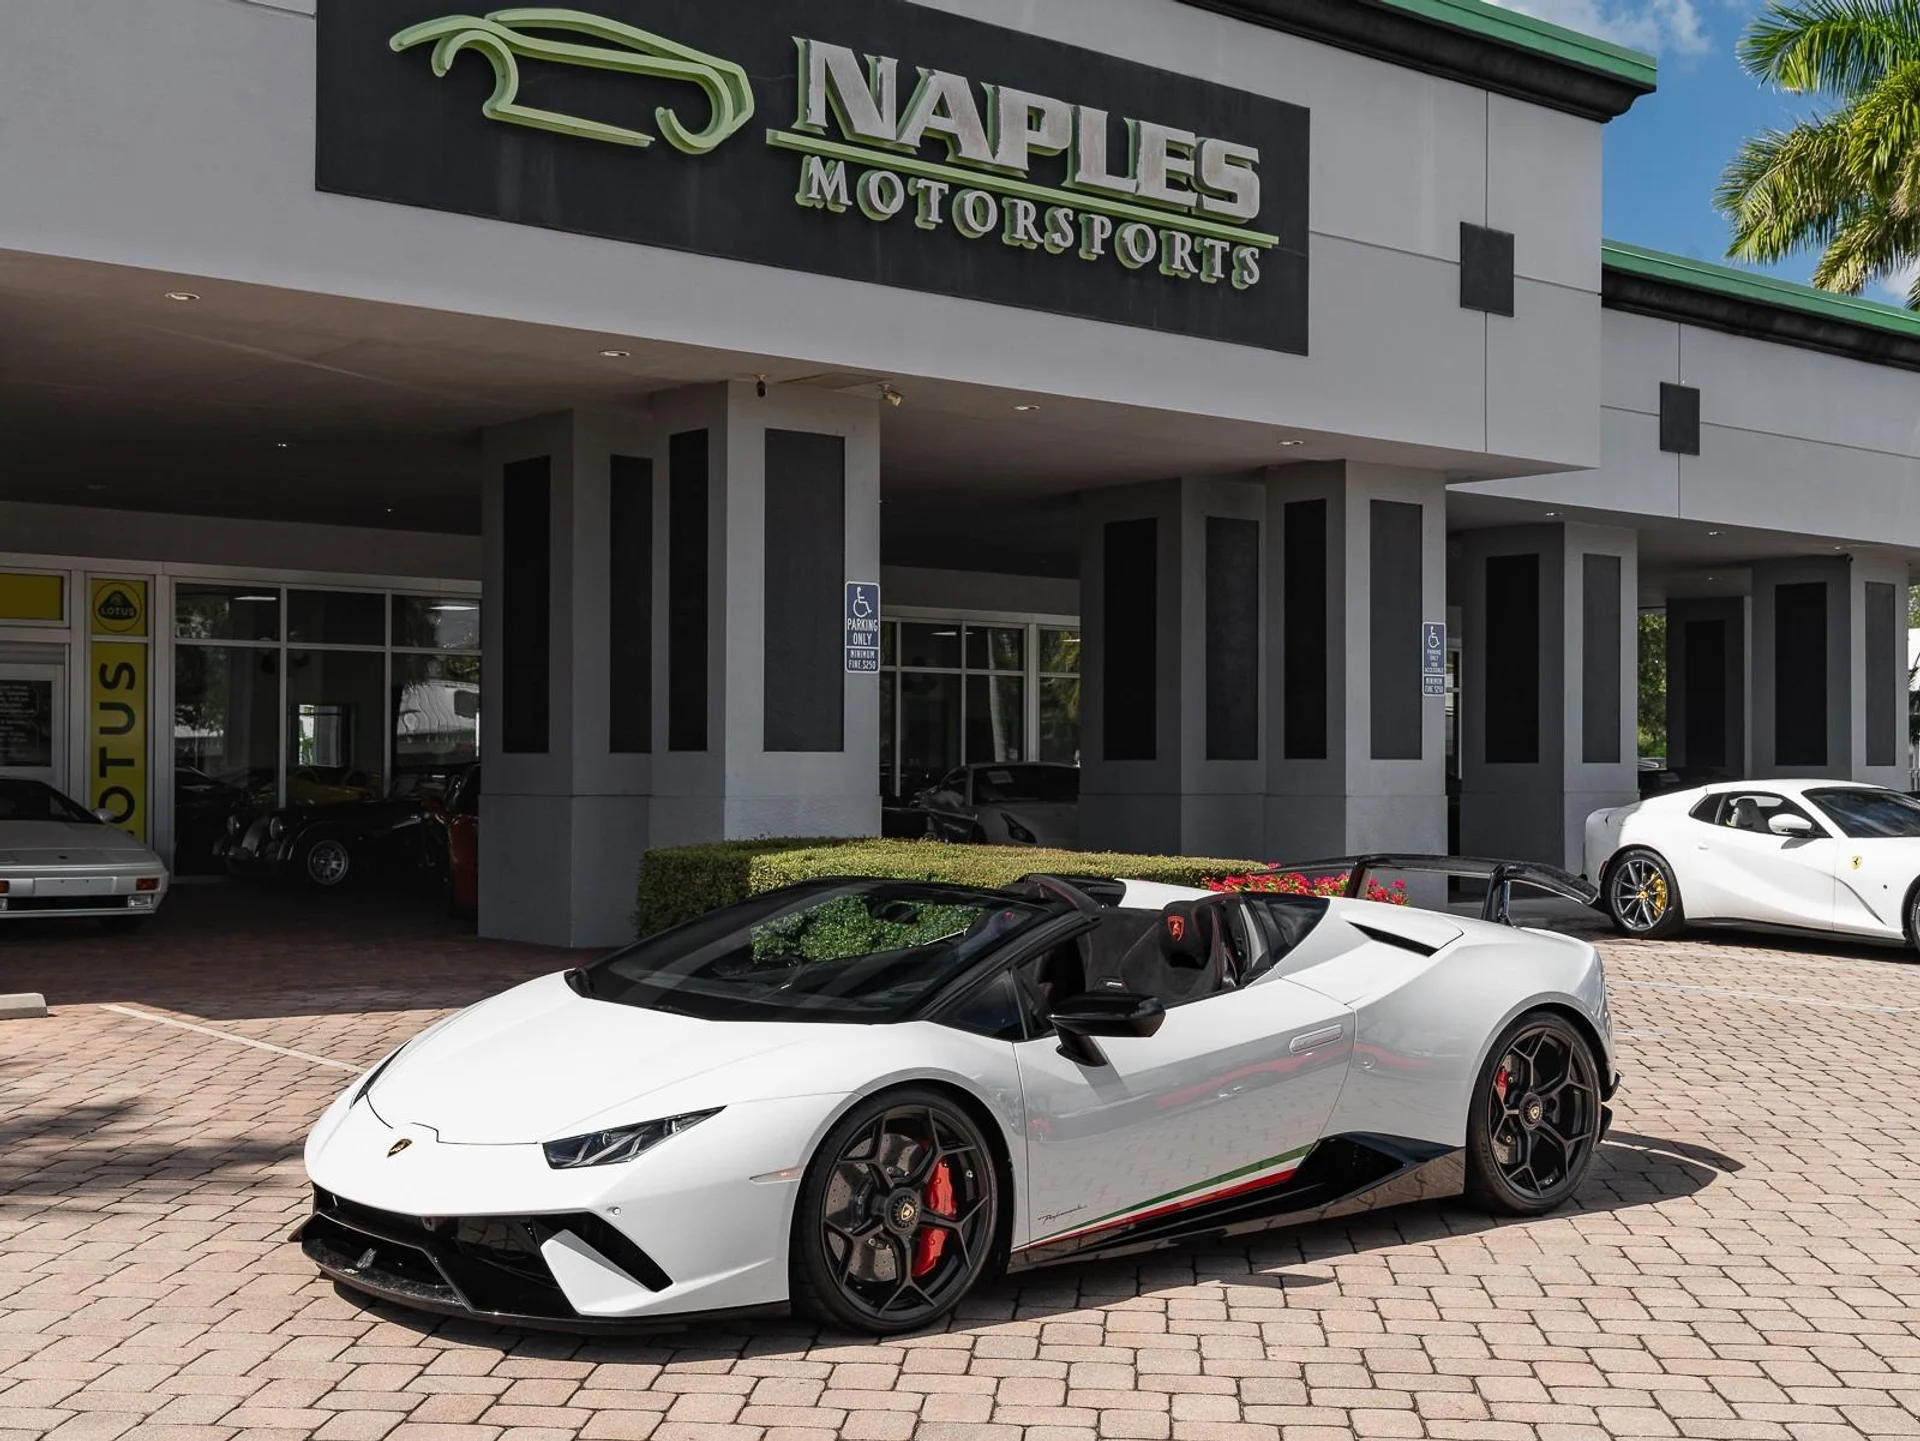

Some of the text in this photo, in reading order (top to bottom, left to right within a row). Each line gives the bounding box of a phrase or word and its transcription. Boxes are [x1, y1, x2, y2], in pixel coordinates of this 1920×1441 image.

[790, 36, 1261, 225] NAPLES
[795, 155, 1261, 290] MOTORSPORTS
[100, 607, 136, 616] LOTUS
[847, 618, 878, 632] PARKING
[853, 632, 872, 646] ONLY
[850, 649, 875, 659] MINIMUM
[848, 660, 861, 669] FINE
[99, 661, 136, 835] OTUS
